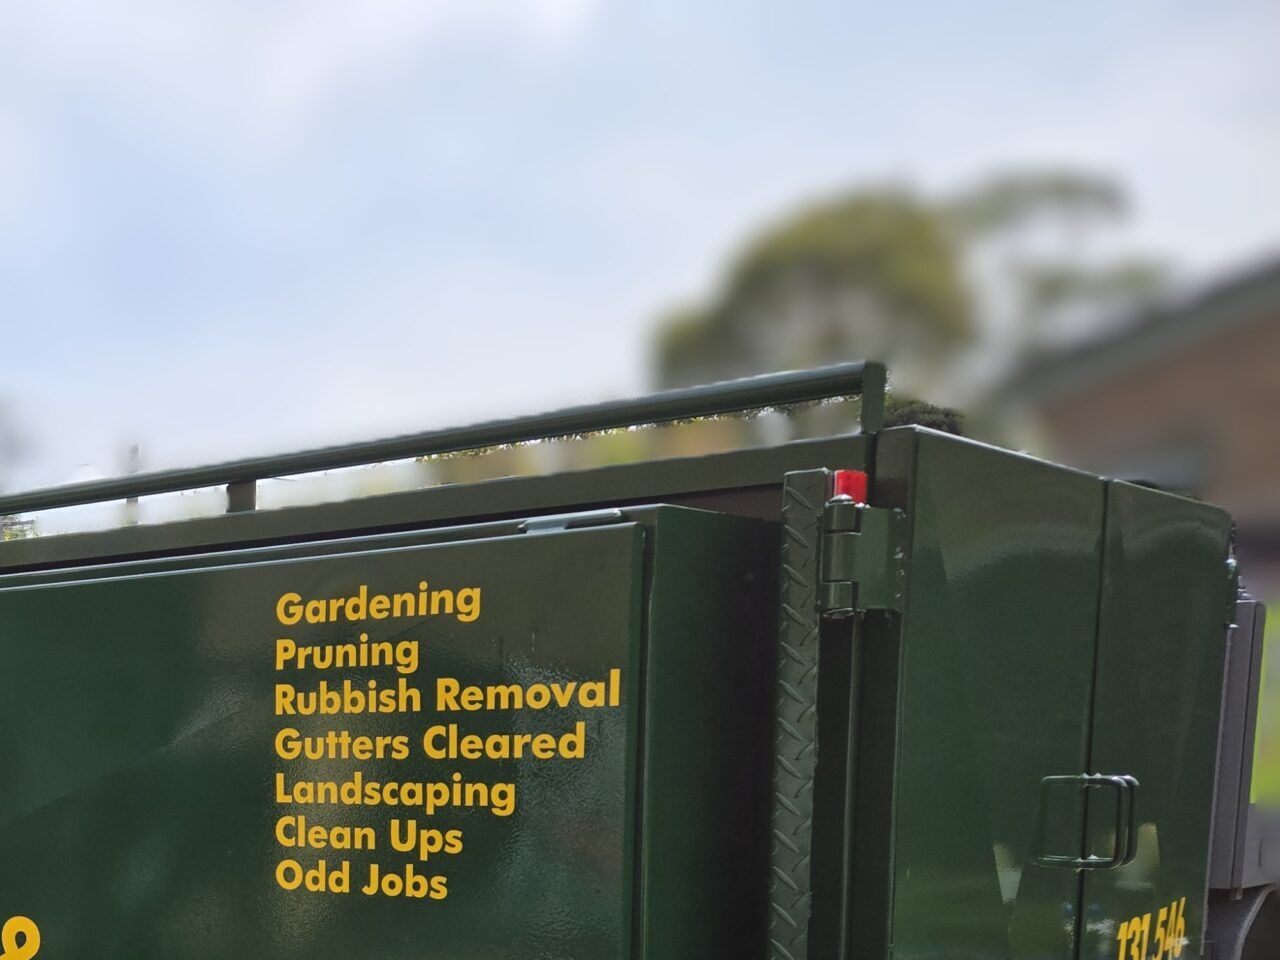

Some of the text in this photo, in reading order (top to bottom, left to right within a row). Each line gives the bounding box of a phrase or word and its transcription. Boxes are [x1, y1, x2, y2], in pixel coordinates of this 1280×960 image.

[276, 580, 482, 626] Gardening
[275, 632, 421, 675] Pruning
[274, 667, 622, 716] Rubbish Removal
[274, 721, 586, 760] Gutters Cleared
[275, 771, 516, 817] Landscaping
[275, 814, 464, 861] Clean Ups
[275, 859, 448, 901] Odd Jobs
